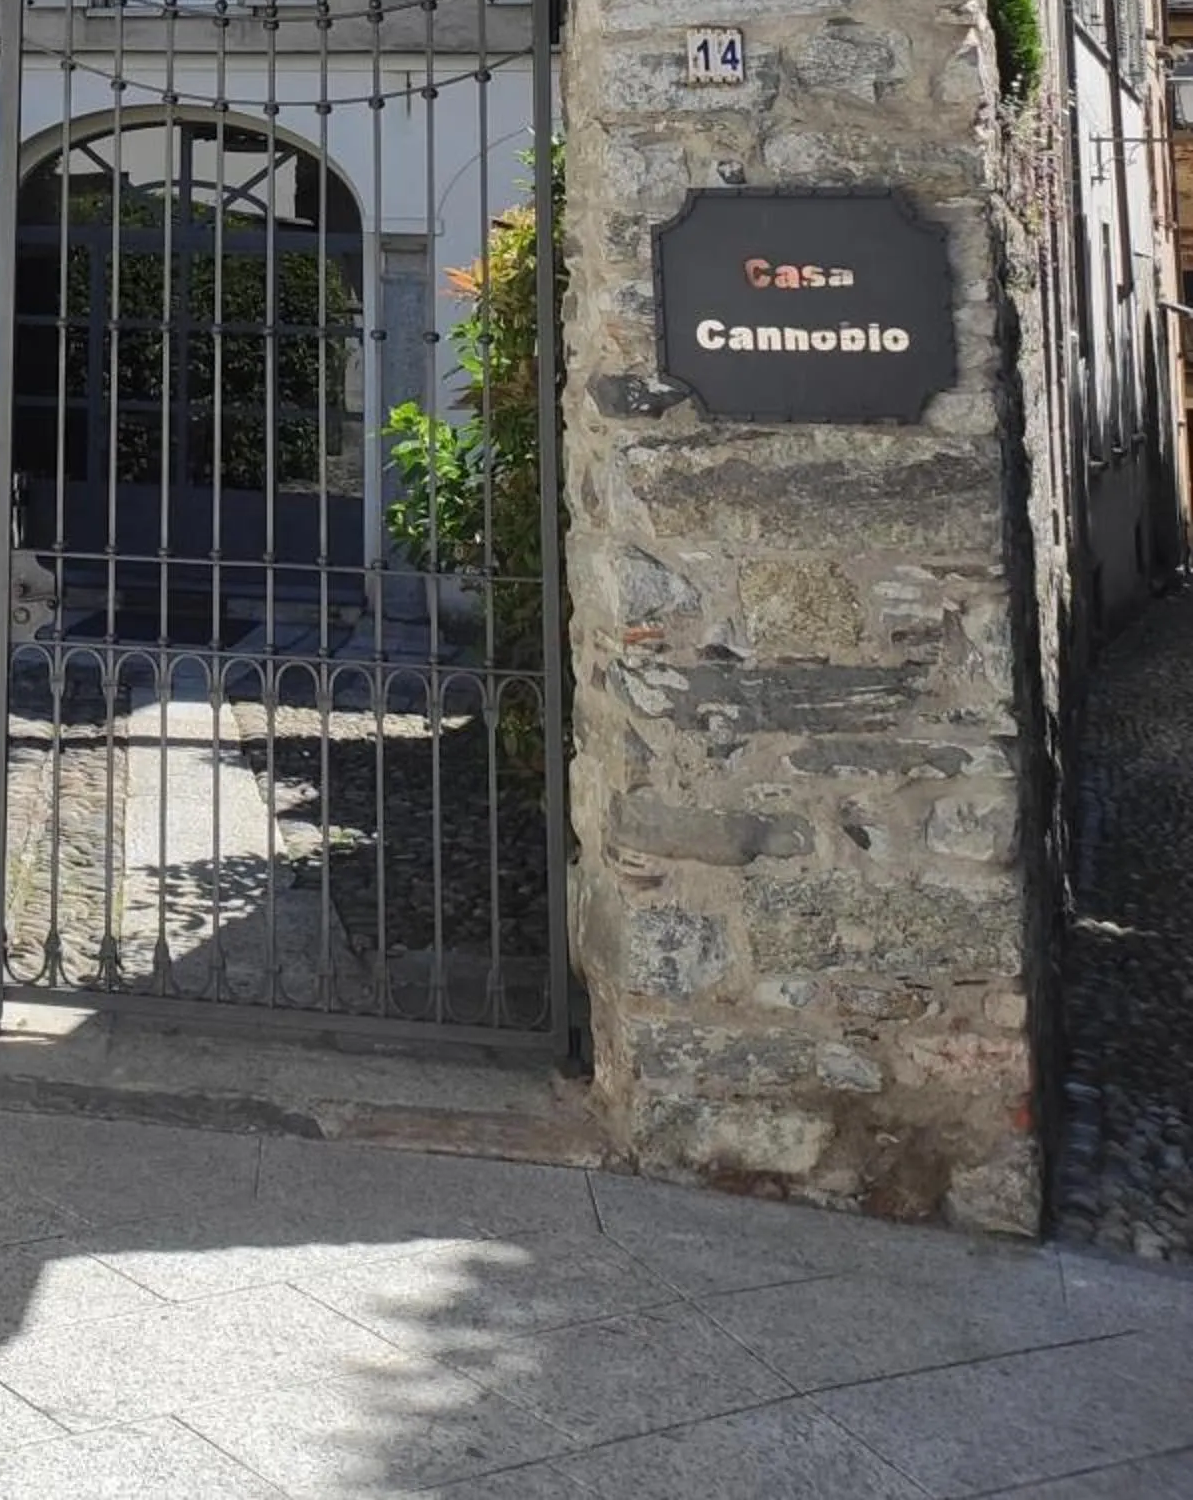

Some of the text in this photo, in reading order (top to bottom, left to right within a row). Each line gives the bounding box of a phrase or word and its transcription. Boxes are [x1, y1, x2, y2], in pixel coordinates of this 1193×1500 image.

[696, 38, 740, 71] 14
[744, 257, 855, 288] Casa
[696, 319, 910, 353] Cannobio
